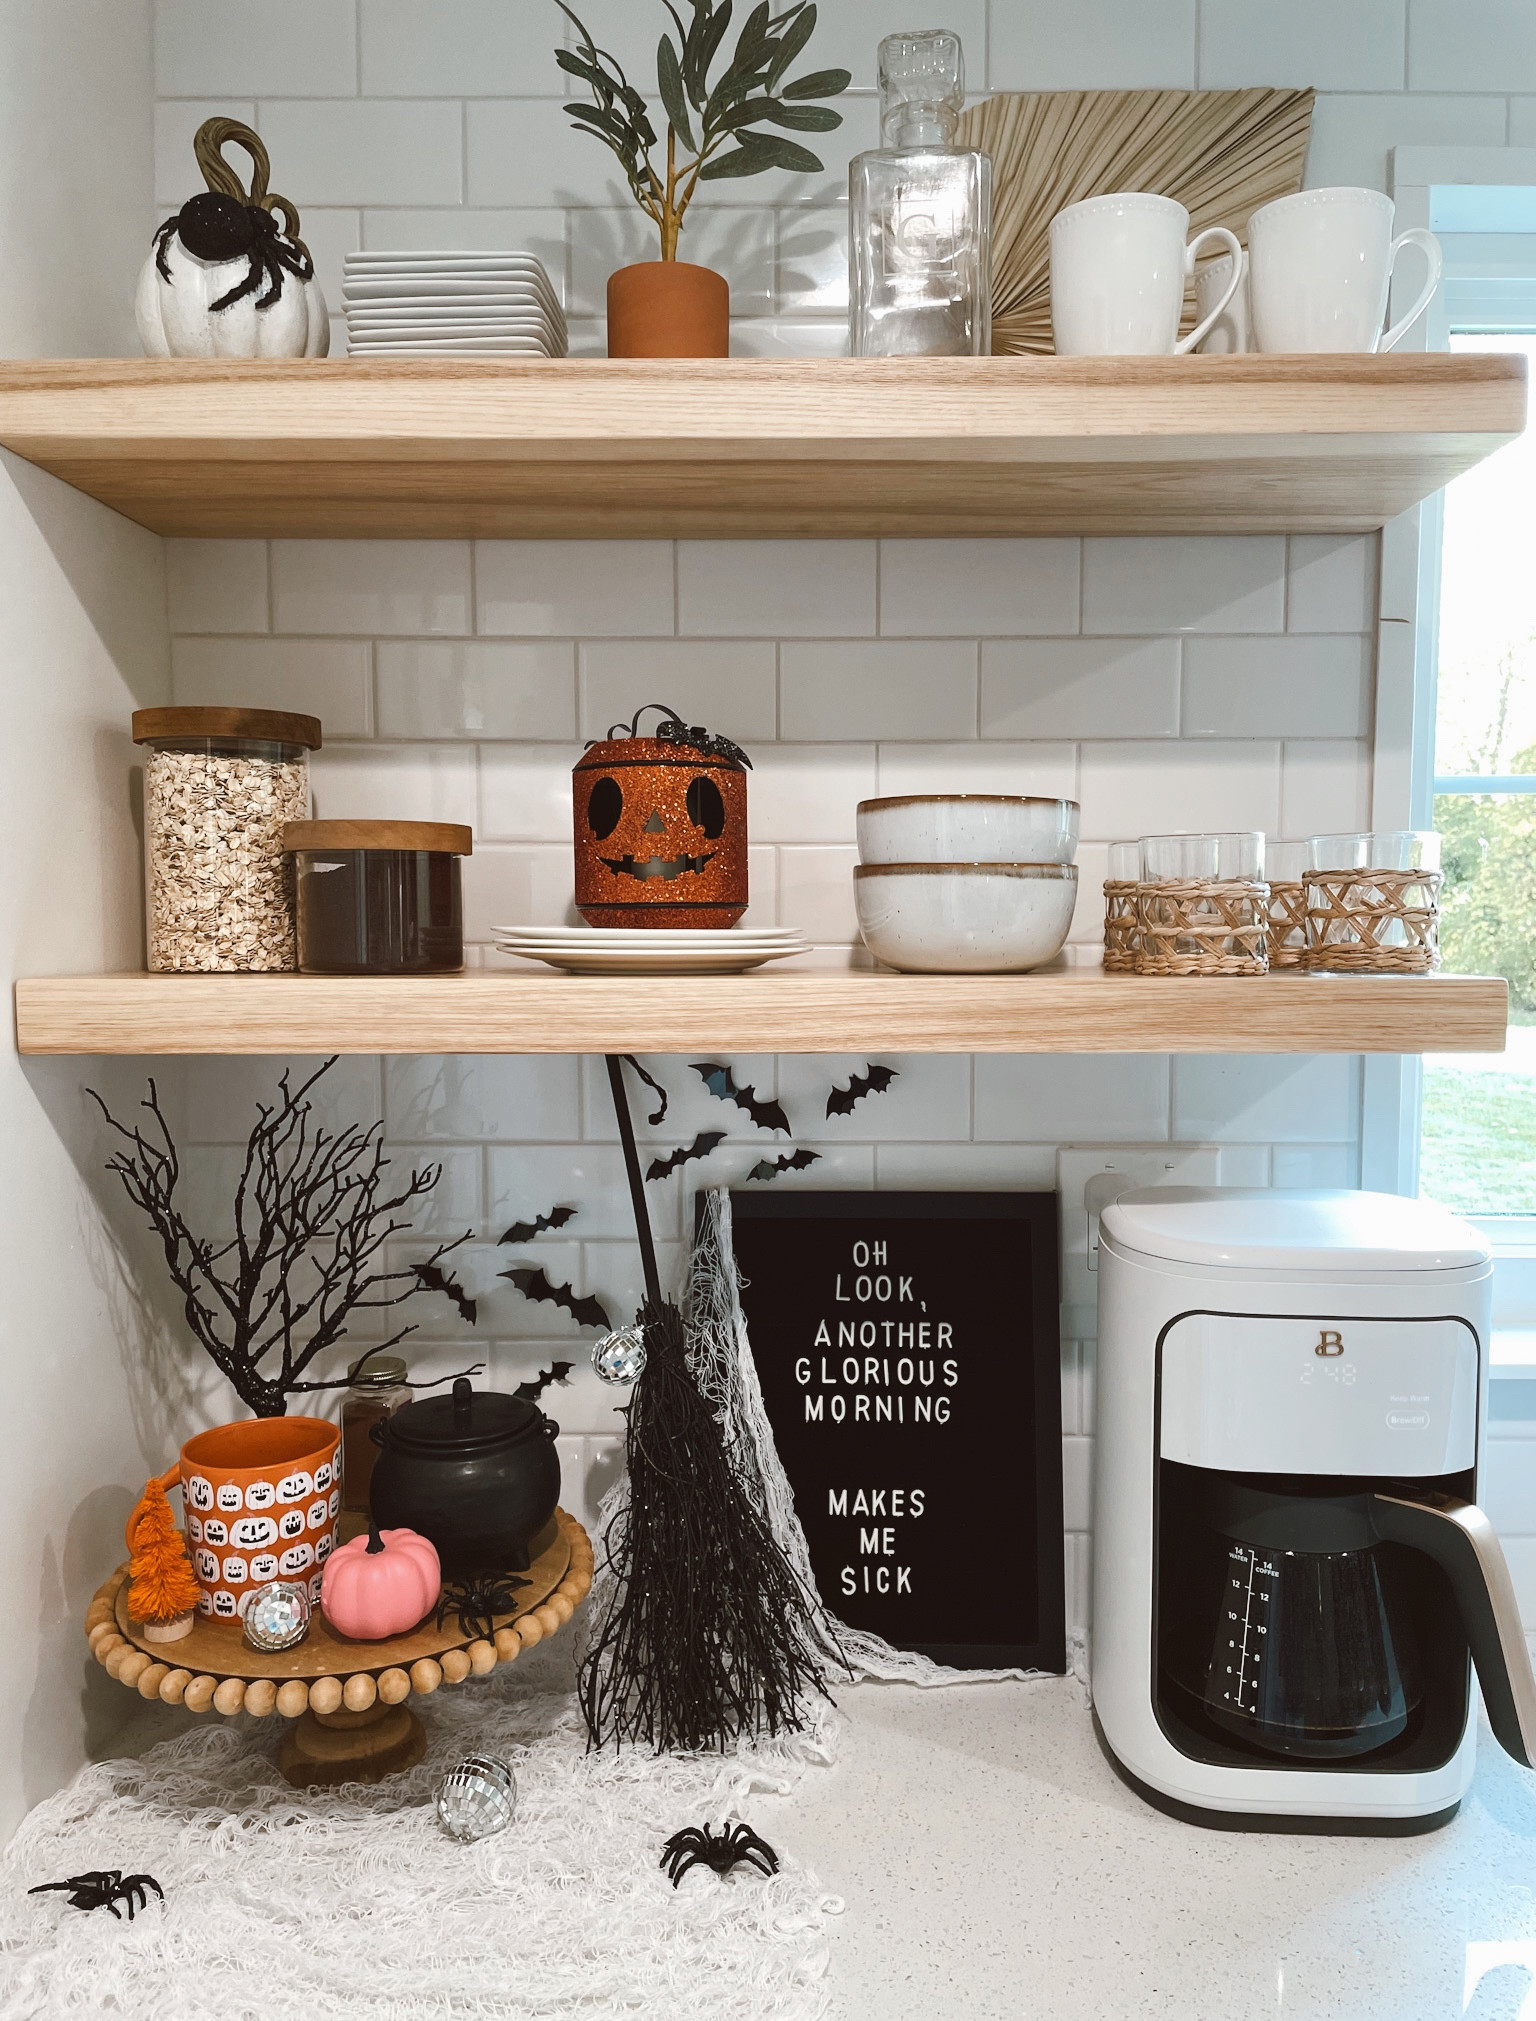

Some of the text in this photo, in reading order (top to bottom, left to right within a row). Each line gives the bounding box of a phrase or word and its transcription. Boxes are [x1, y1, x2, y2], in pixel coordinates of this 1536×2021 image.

[852, 1240, 887, 1268] OH
[835, 1273, 927, 1313] LOOK,
[813, 1318, 953, 1350] ANOTHER
[1314, 1330, 1345, 1357] B
[795, 1356, 959, 1388] GLORIOUS
[804, 1394, 951, 1425] MORNING
[828, 1488, 926, 1519] MAKES
[859, 1527, 896, 1557] ME
[1234, 1546, 1244, 1556] 14
[1228, 1552, 1249, 1563] WATER
[1262, 1561, 1273, 1570] 14
[1255, 1566, 1280, 1578] COFFEE
[840, 1564, 912, 1596] SICK
[1231, 1579, 1241, 1589] 12
[1259, 1592, 1270, 1602] 12
[1227, 1611, 1238, 1621] 10
[1256, 1625, 1267, 1635] 10
[1228, 1639, 1235, 1648] 8
[1253, 1653, 1261, 1662] 8
[1226, 1665, 1233, 1674] 6
[1251, 1680, 1259, 1689] 6
[1223, 1691, 1230, 1700] 4
[1249, 1705, 1256, 1714] 4
